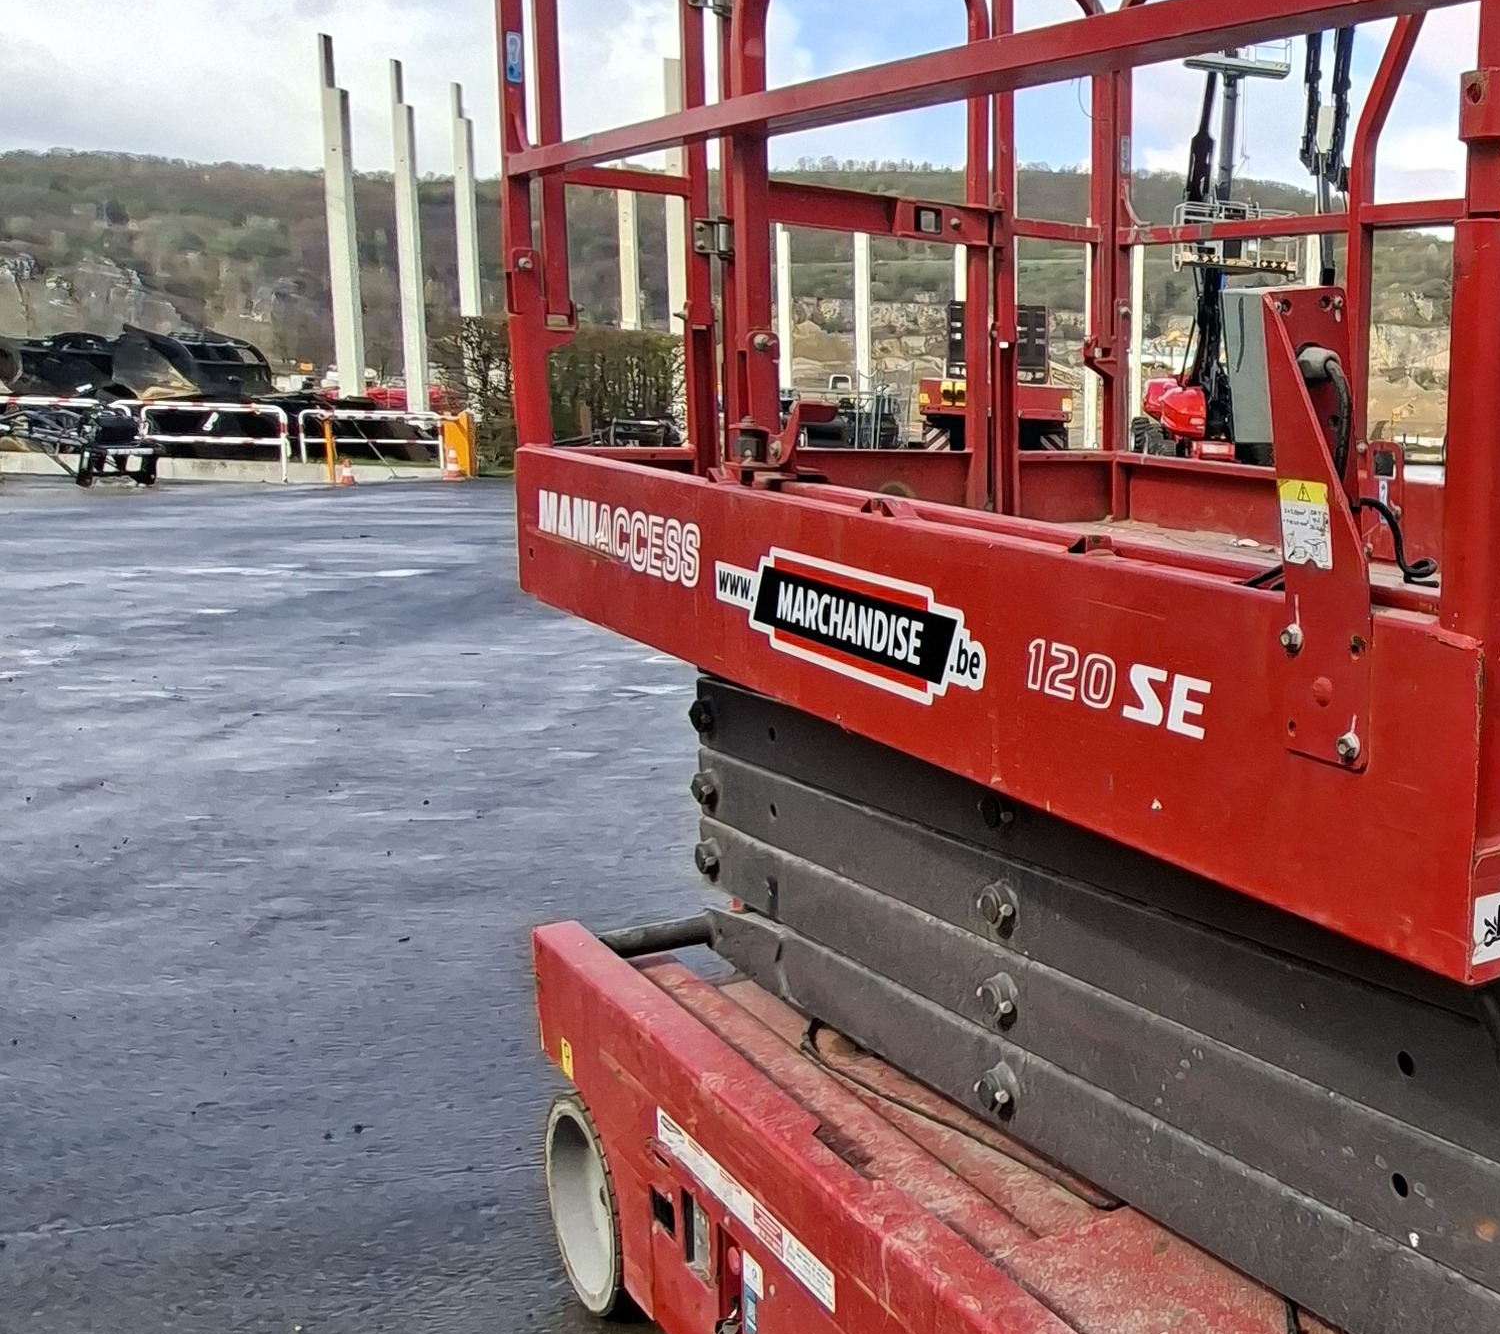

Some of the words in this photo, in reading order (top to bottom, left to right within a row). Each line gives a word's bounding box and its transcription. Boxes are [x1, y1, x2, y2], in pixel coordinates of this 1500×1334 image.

[538, 488, 701, 588] MANIACCESS
[776, 580, 925, 666] MARCHANDISE
[1027, 638, 1117, 709] 120
[1122, 663, 1212, 741] SE
